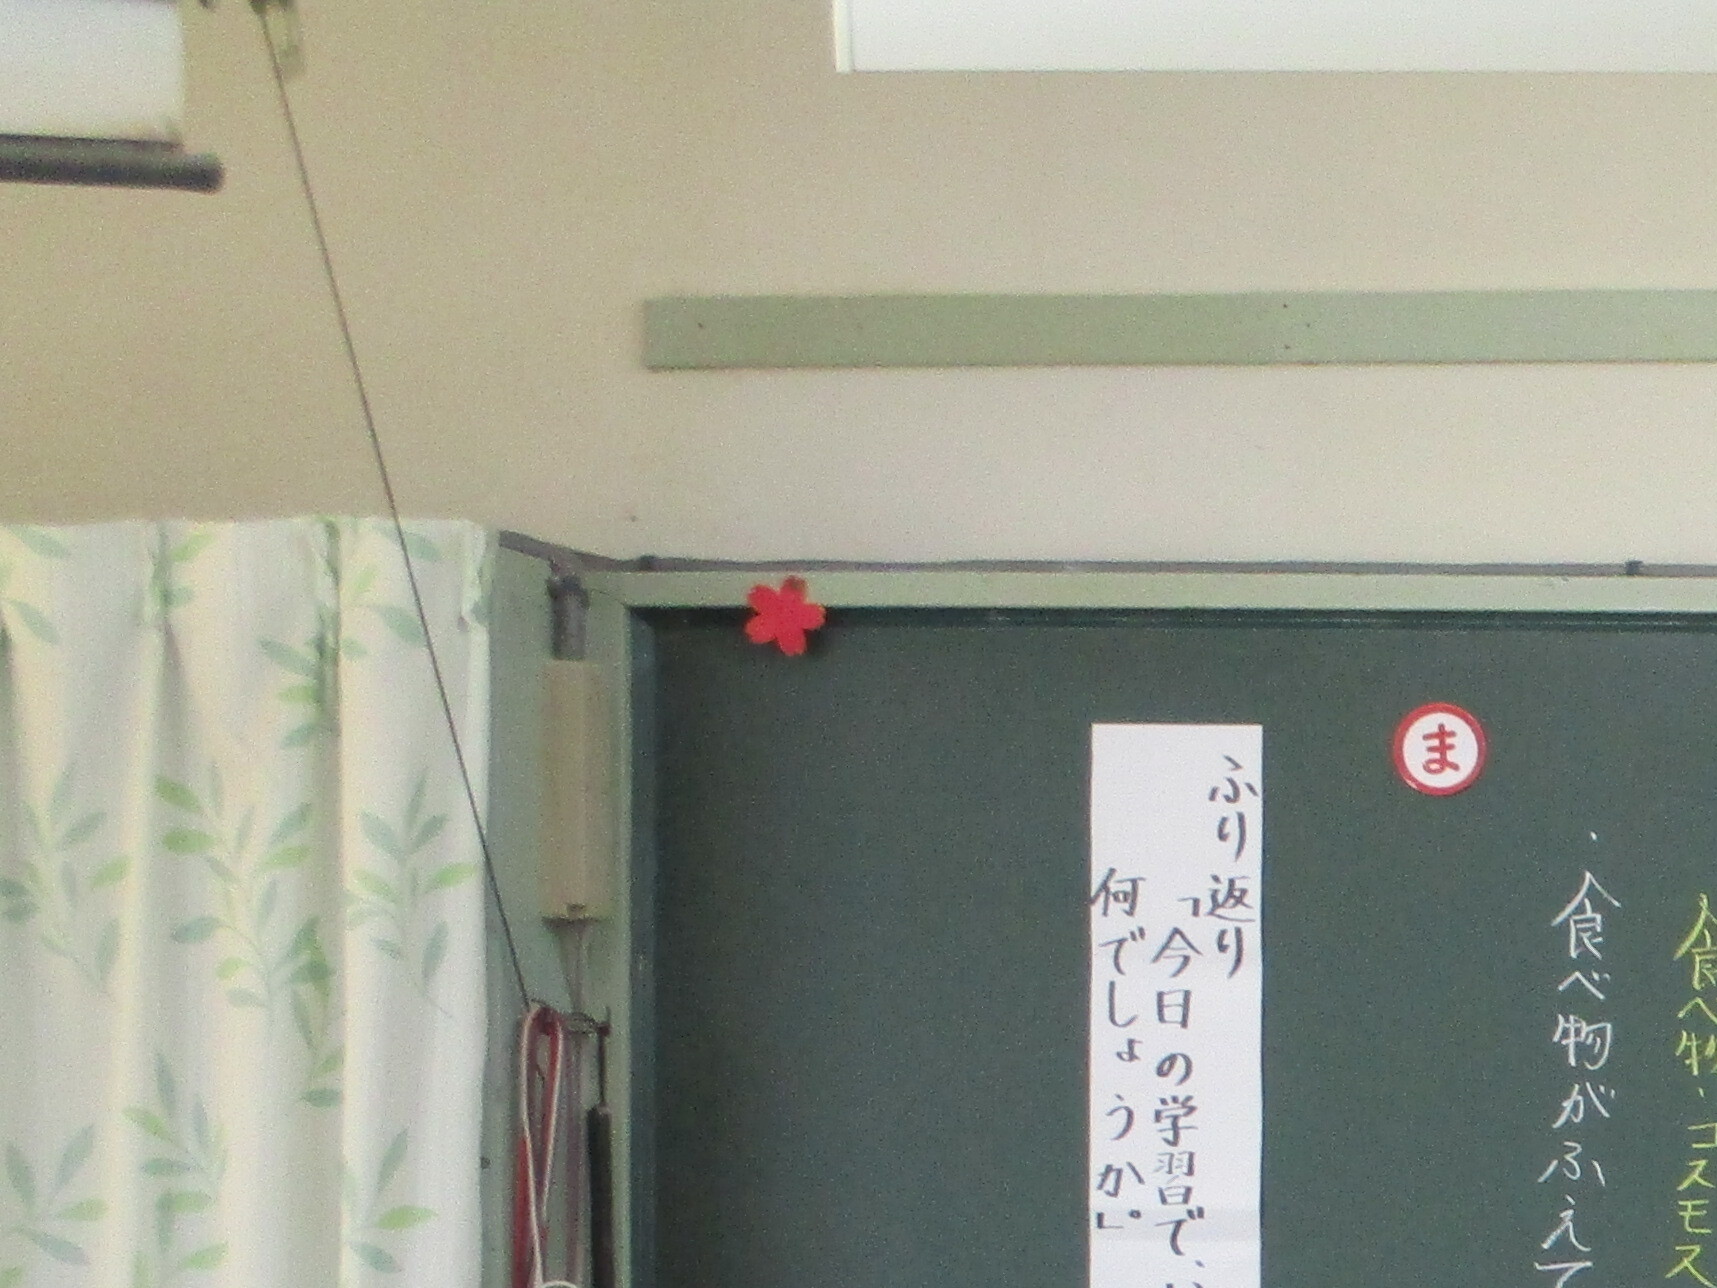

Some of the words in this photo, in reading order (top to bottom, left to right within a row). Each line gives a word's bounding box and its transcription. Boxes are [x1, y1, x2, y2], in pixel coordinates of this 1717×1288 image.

[1421, 724, 1461, 775] ま
[1207, 755, 1259, 979] ふり返り
